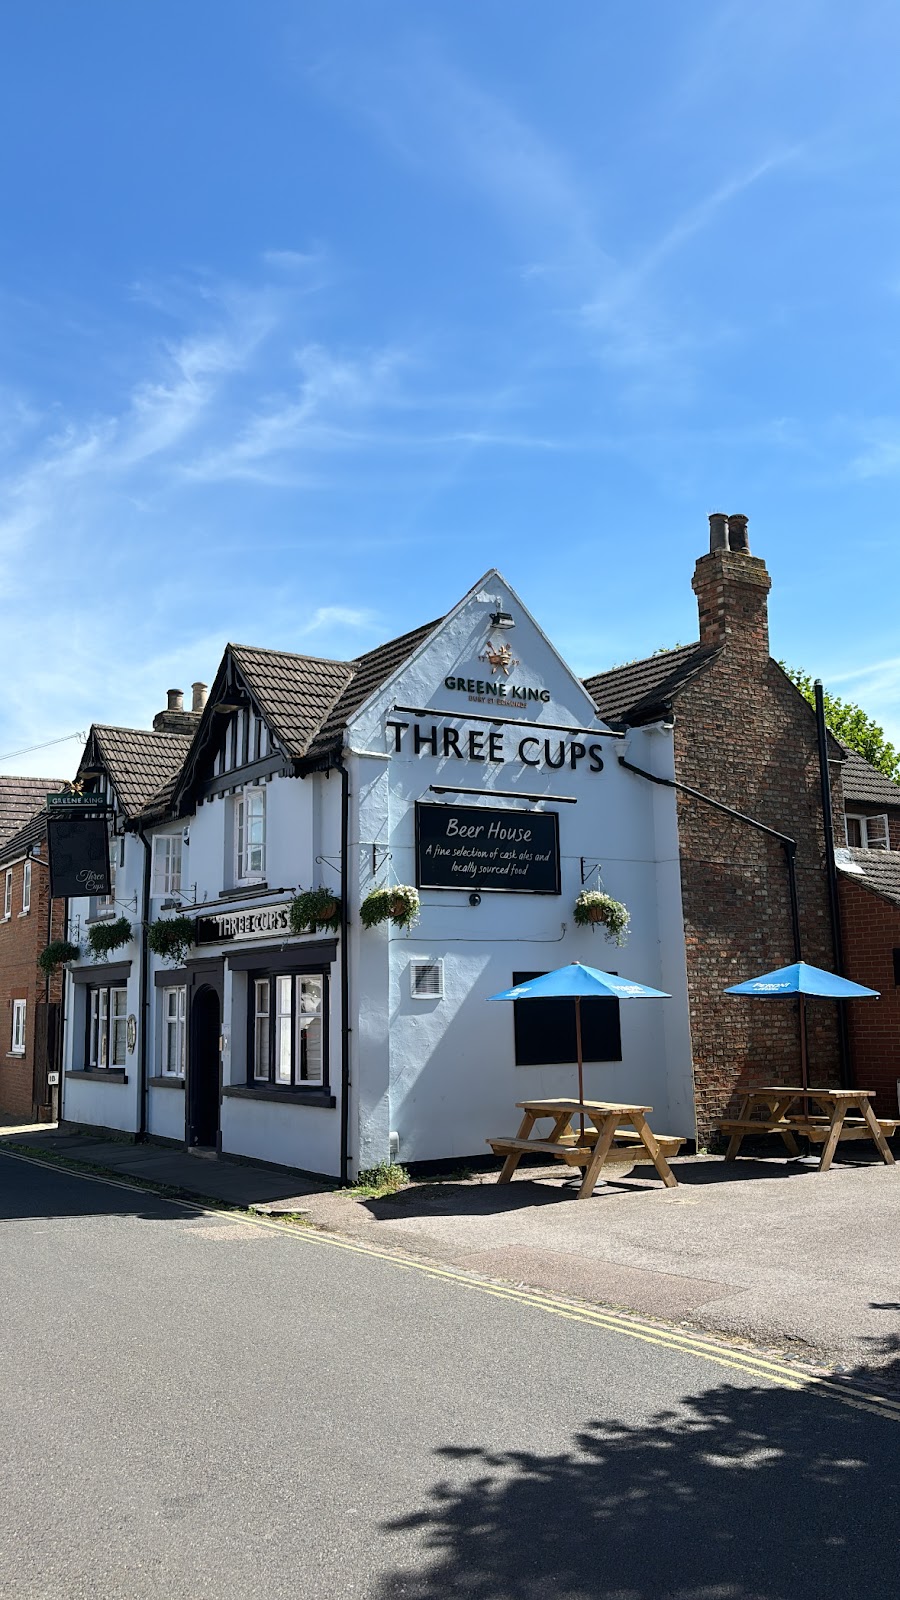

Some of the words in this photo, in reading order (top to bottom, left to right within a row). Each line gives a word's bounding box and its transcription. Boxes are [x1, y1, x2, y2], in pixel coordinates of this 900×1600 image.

[445, 676, 506, 697] GREENE
[512, 685, 550, 702] KING
[387, 721, 504, 763] THREE
[518, 737, 604, 772] CUPS
[446, 818, 484, 838] Beer
[487, 821, 532, 842] House
[425, 844, 432, 855] A
[433, 844, 451, 858] fine
[452, 846, 488, 858] selection
[489, 848, 499, 859] of
[500, 850, 517, 859] cask
[518, 850, 533, 860] ales
[535, 850, 551, 861] and
[76, 870, 104, 883] Three
[451, 861, 477, 878] locally
[479, 863, 511, 874] sourced
[511, 864, 529, 876] food
[85, 881, 104, 892] Cups
[218, 916, 250, 936] THREE
[253, 911, 285, 931] CUPS
